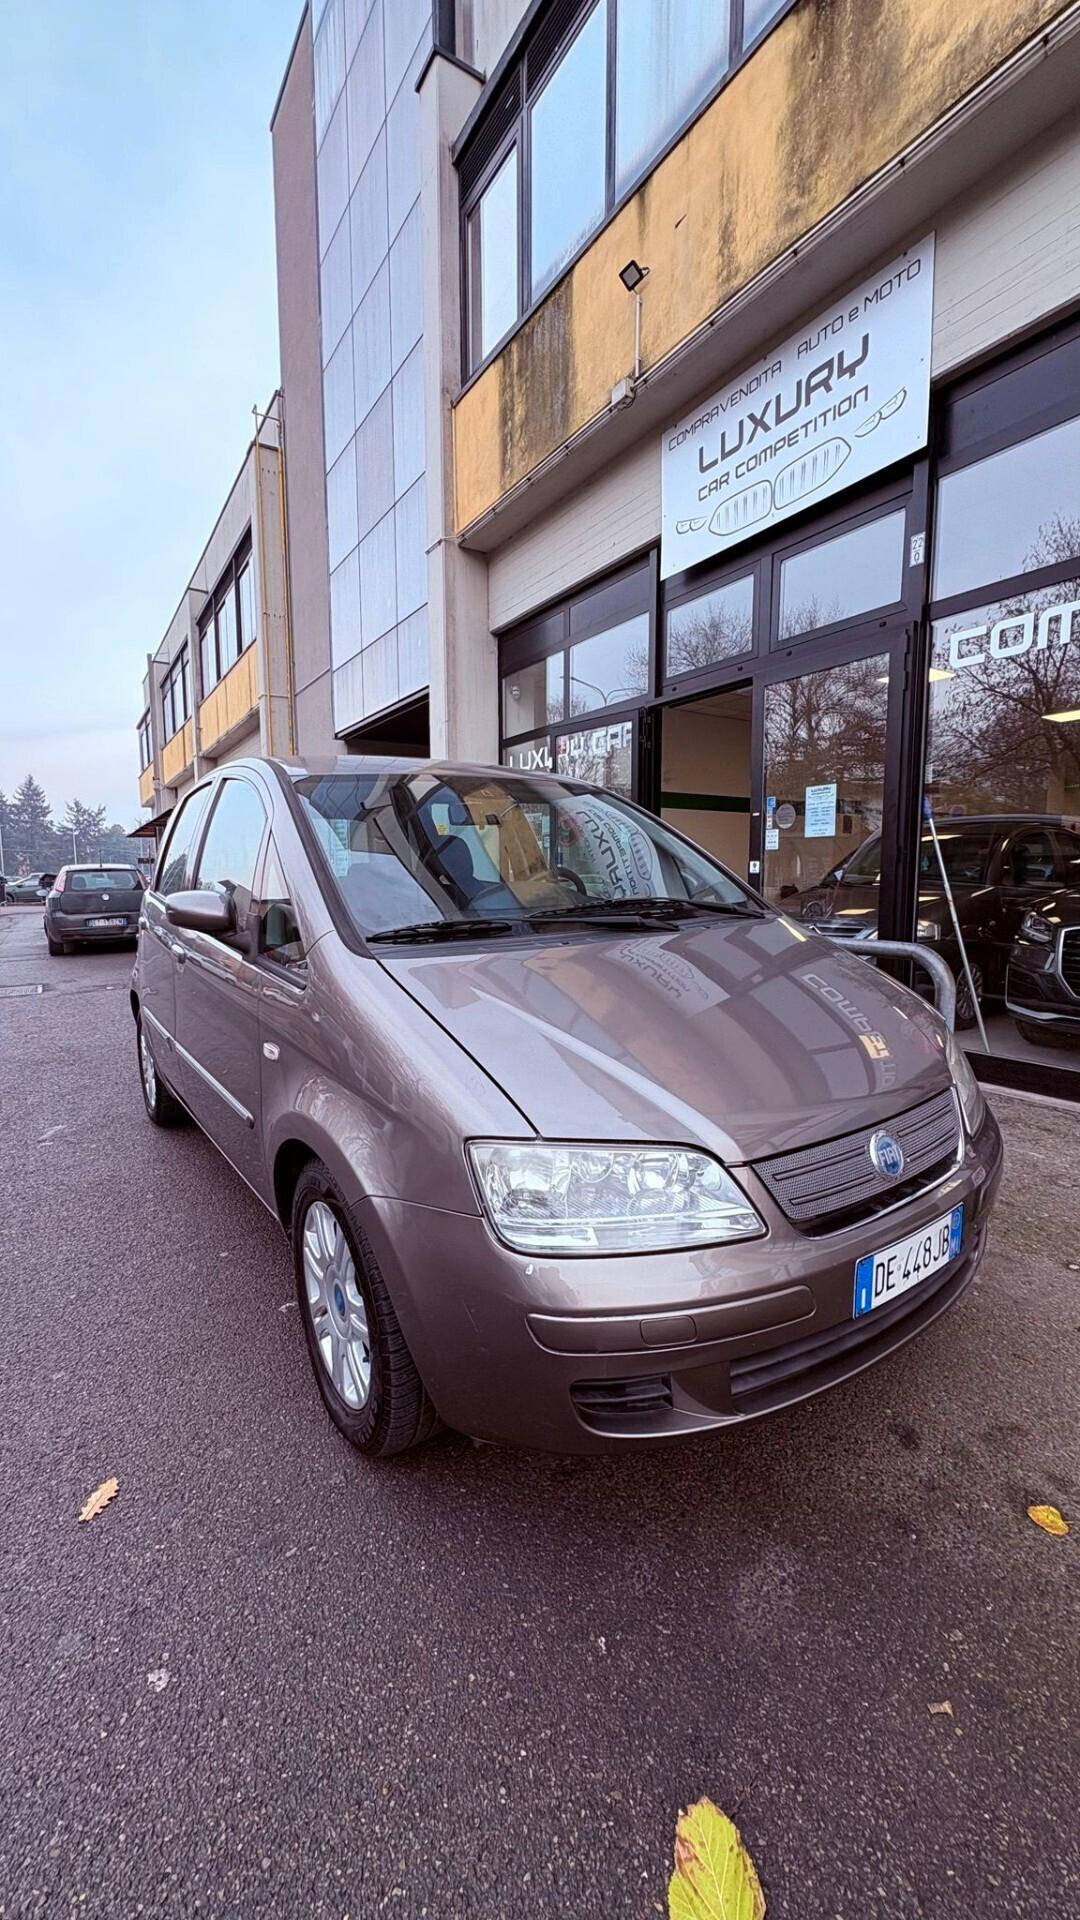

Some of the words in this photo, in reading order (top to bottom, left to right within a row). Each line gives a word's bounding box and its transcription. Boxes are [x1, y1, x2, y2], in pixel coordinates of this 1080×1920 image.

[667, 359, 783, 452] COMPRAVENDITA
[796, 314, 845, 361] AUTO
[847, 304, 860, 324] e
[863, 257, 922, 313] MOTO
[698, 331, 871, 475] LUXURY
[697, 470, 731, 503] CAR
[734, 384, 870, 481] COMPETITION
[874, 1255, 898, 1299] DE
